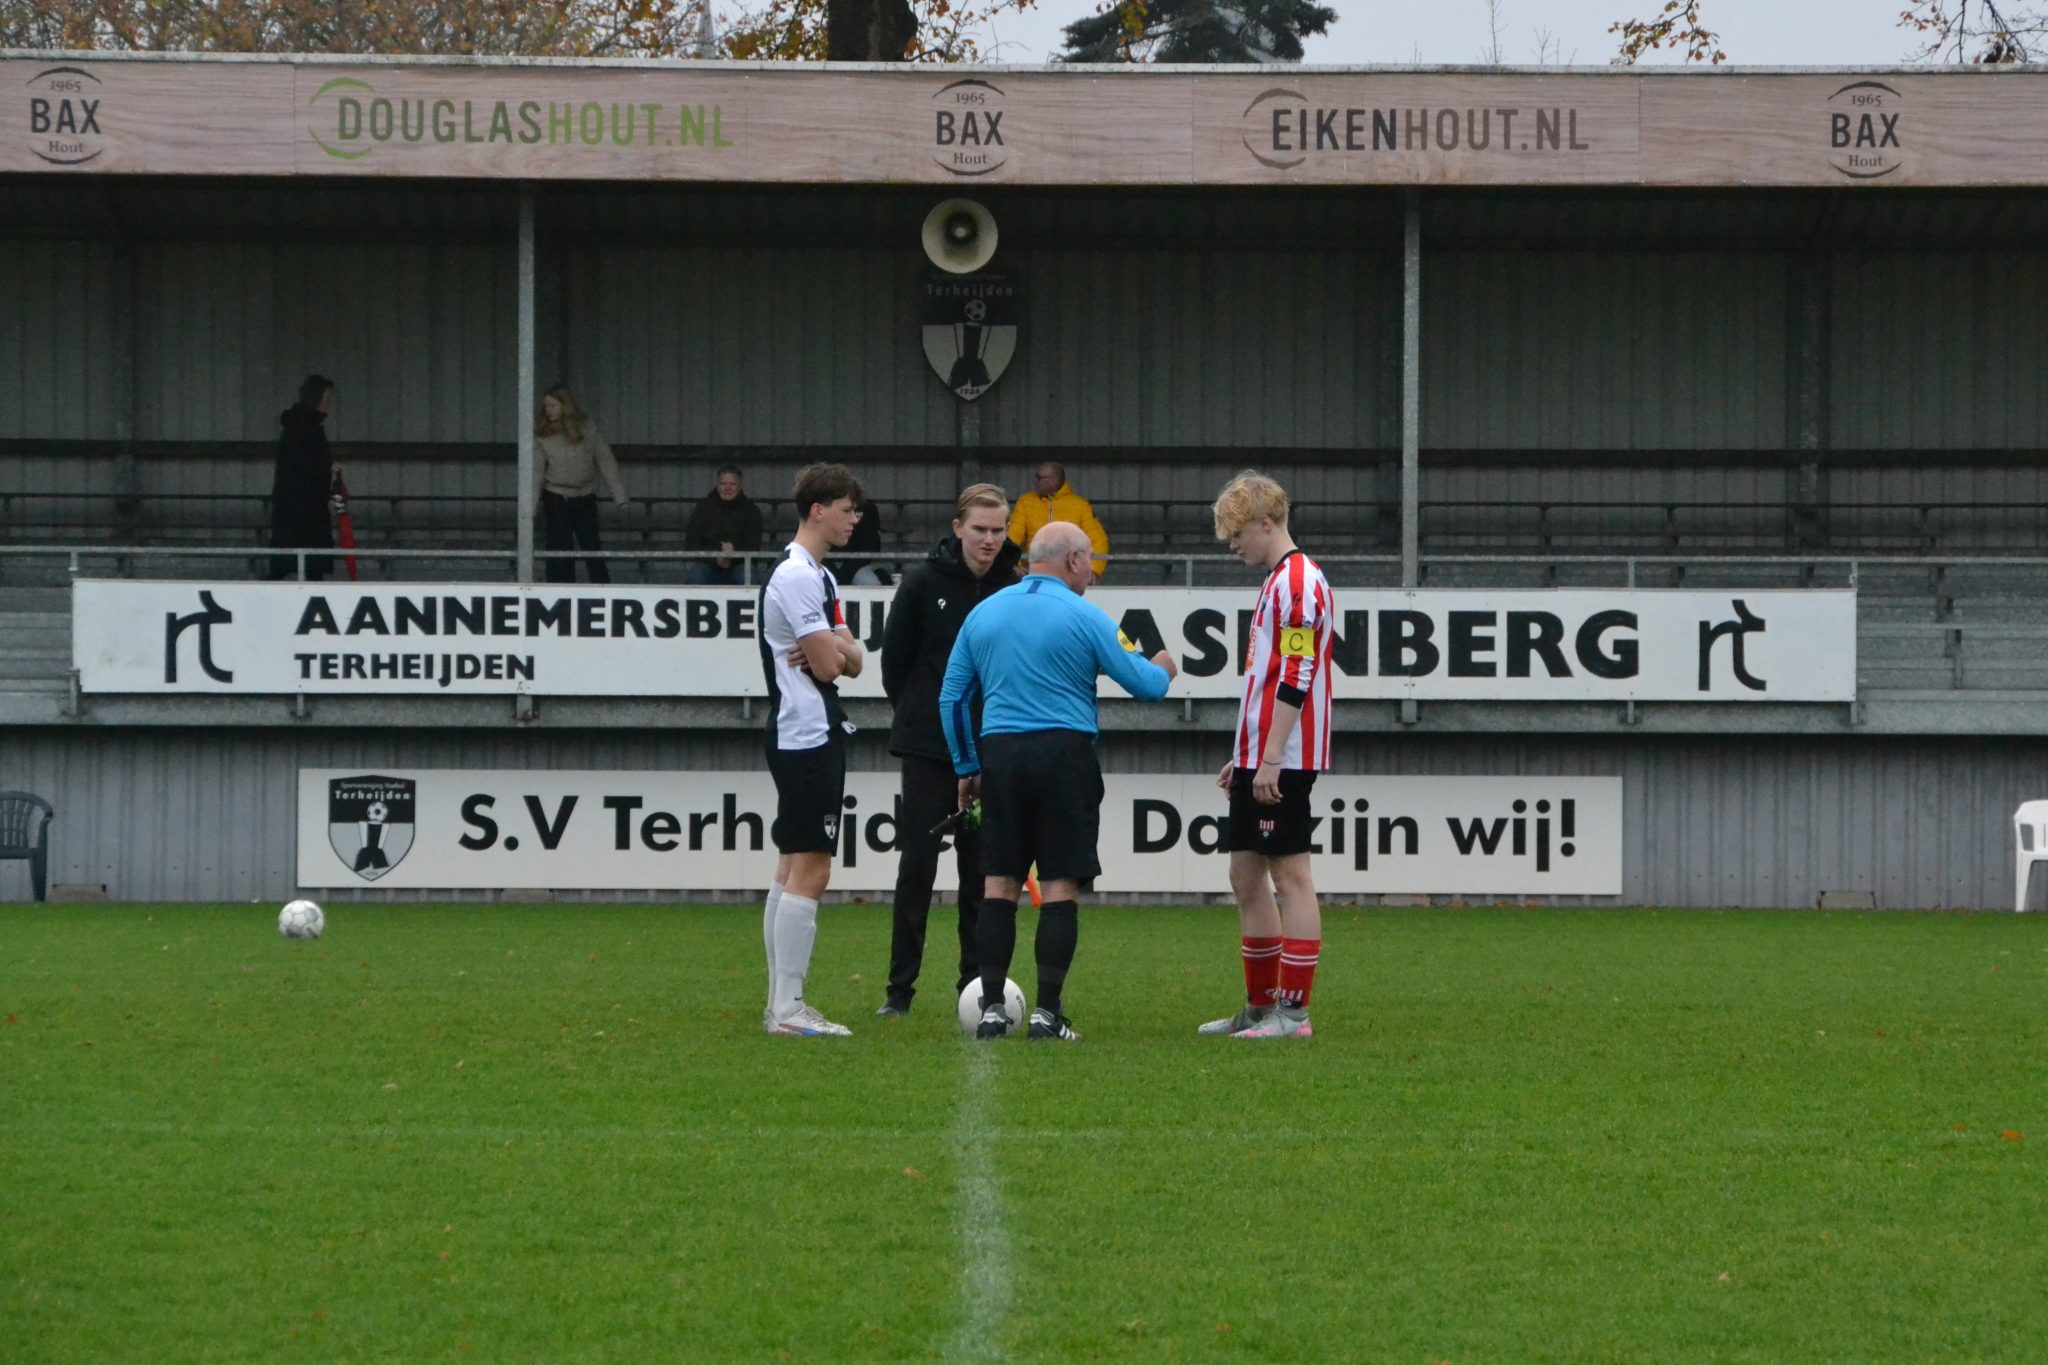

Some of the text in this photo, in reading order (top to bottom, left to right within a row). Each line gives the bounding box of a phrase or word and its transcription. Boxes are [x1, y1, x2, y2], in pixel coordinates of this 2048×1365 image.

[50, 80, 81, 93] 1965
[956, 92, 985, 105] 1965
[1851, 94, 1882, 107] 1965
[31, 98, 101, 134] BAX
[338, 97, 734, 148] DOUGLASHOUT.NL
[936, 111, 1004, 146] BAX
[1272, 108, 1589, 150] EIKENHOUT.NL
[1831, 113, 1901, 148] BAX
[48, 141, 84, 153] Hout
[953, 152, 987, 164] Hout
[1848, 155, 1882, 167] Hout
[294, 596, 886, 653] AANNEMERSBEIJ
[1288, 632, 1304, 652] C
[294, 653, 535, 687] TERHEIJDEN
[334, 789, 411, 801] Terheijden
[458, 794, 579, 852] S.V
[1132, 798, 1231, 856] Da
[1446, 798, 1576, 872] wij!
